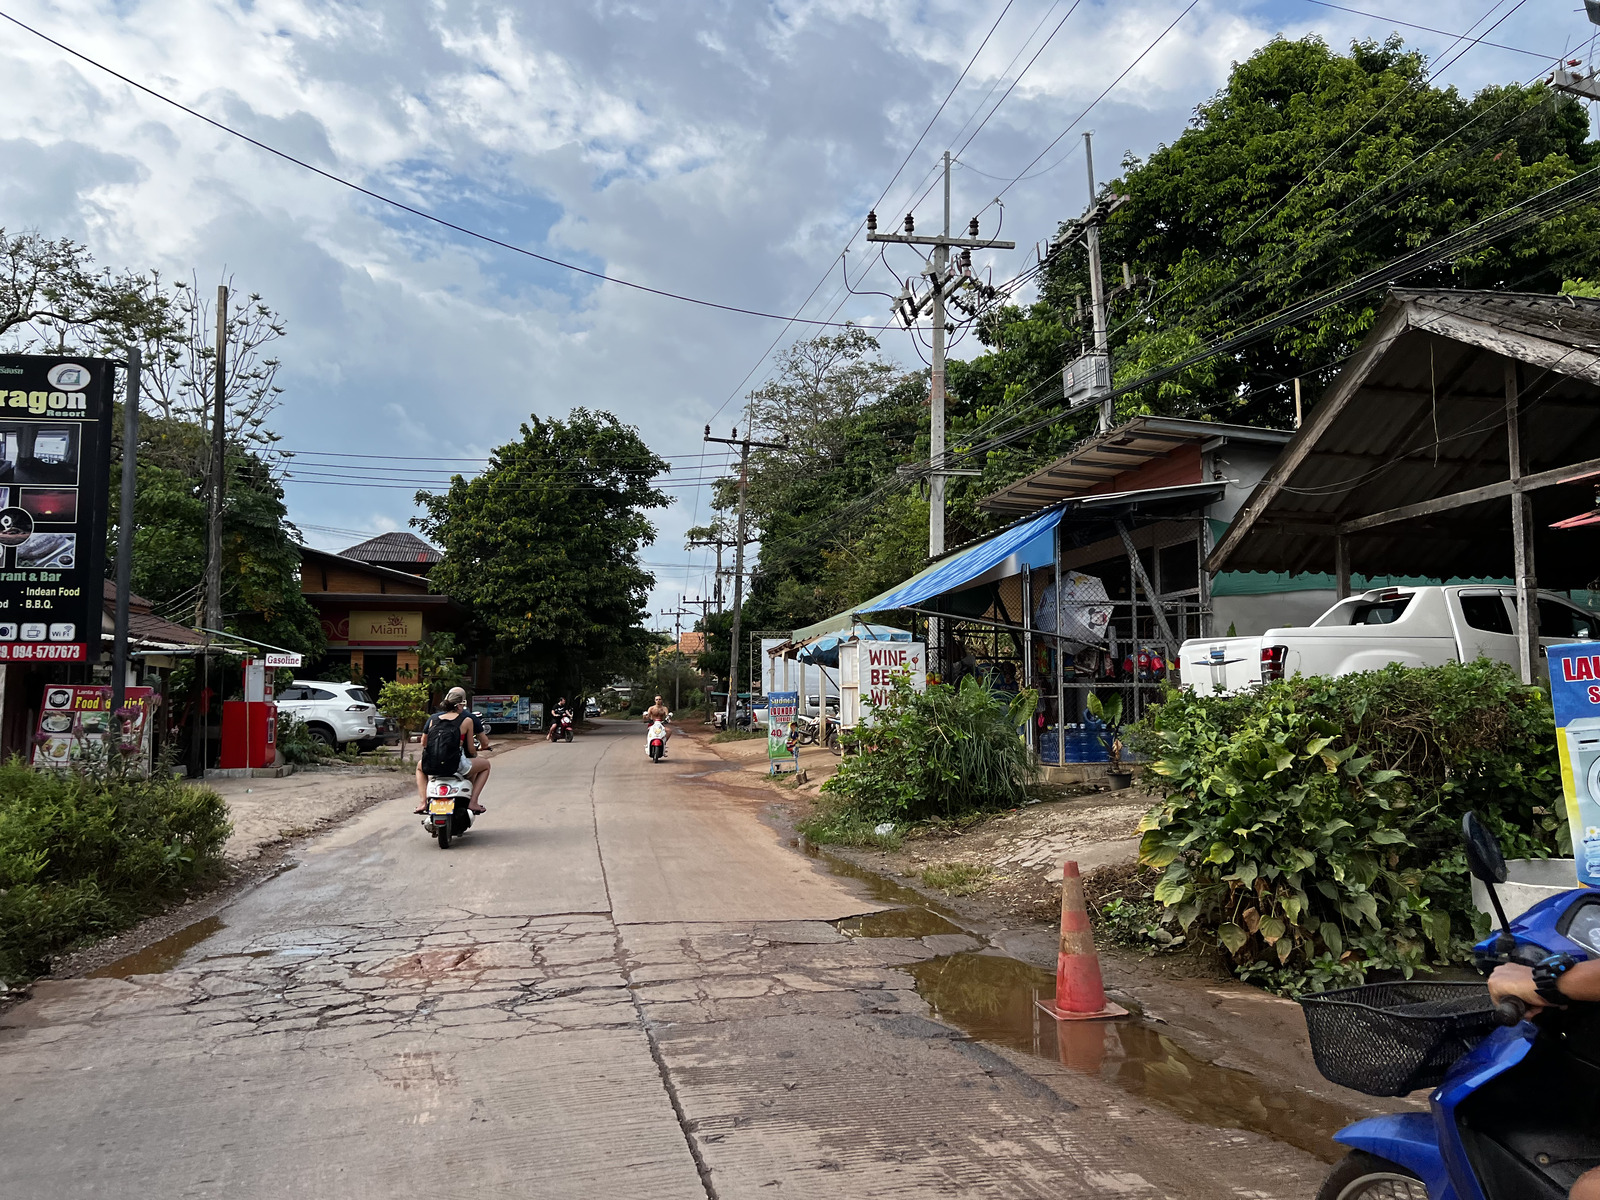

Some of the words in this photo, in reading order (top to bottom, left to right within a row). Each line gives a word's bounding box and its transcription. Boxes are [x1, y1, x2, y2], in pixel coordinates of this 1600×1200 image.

[46, 409, 86, 417] Resort
[28, 572, 38, 582] &
[40, 571, 62, 582] Bar
[26, 587, 57, 596] Indean
[58, 587, 80, 596] Food
[25, 599, 54, 609] B.B.Q.
[371, 624, 407, 634] Miami
[12, 645, 80, 659] 094-5787673
[267, 655, 300, 665] Gasoline
[869, 649, 907, 666] WINE
[75, 696, 100, 709] Food
[770, 729, 783, 738] 40
